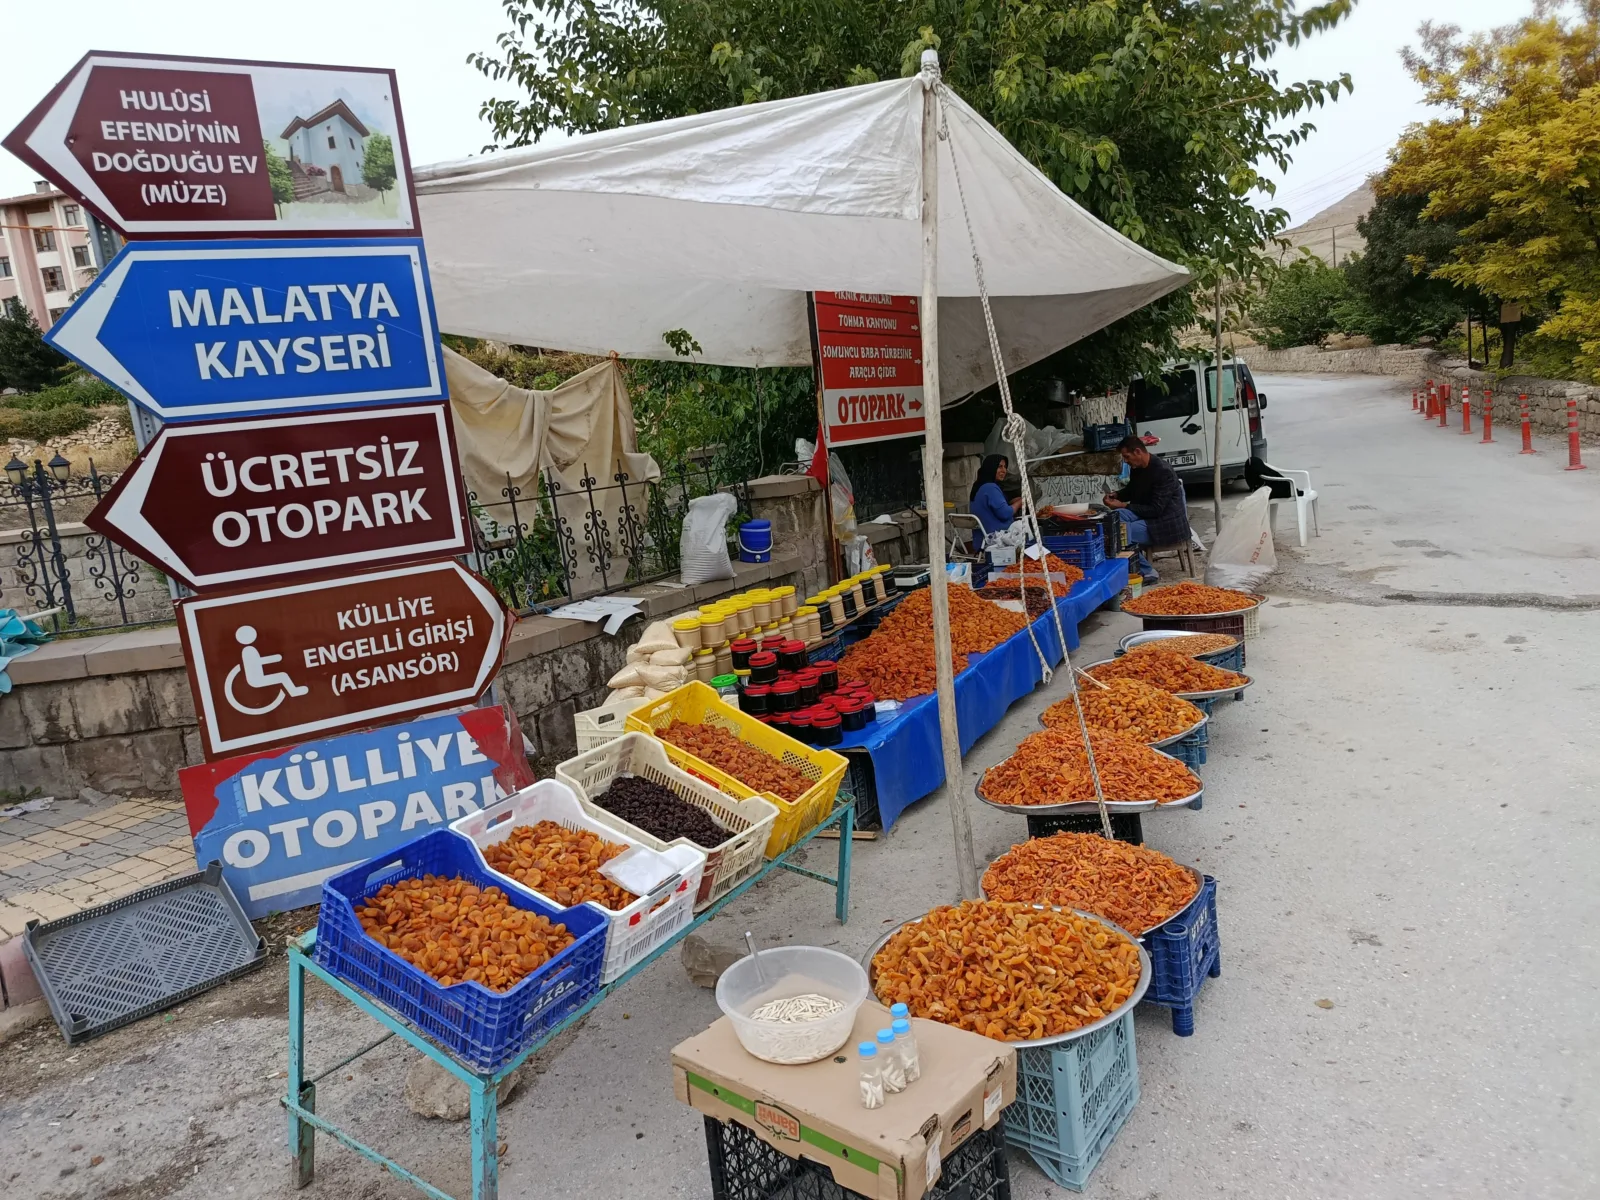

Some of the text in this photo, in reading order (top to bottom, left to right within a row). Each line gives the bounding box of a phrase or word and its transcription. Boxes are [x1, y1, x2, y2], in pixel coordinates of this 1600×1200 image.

[119, 88, 212, 113] HULÛSİ
[100, 119, 241, 144] EFENDİ'NİN
[92, 149, 258, 174] DOĞDUĞU EV
[141, 180, 227, 206] (MÜZE)
[168, 282, 400, 328] MALATYA
[838, 314, 897, 330] TOHMA KANYONU
[195, 324, 393, 380] KAYSERİ
[823, 345, 912, 360] SOMUNCU BABA TÜRBESİNE
[849, 363, 897, 381] ARAÇLA GİDER
[837, 393, 906, 424] OTOPARK
[200, 435, 424, 497] ÜCRETSİZ
[212, 488, 432, 548] OTOPARK
[336, 596, 435, 631] KÜLLİYE
[302, 615, 474, 669] ENGELLİ GİRİŞİ
[331, 651, 460, 697] (ASANSÖR)
[240, 731, 488, 814] KÜLLİYE
[758, 1104, 798, 1137] Banvit
